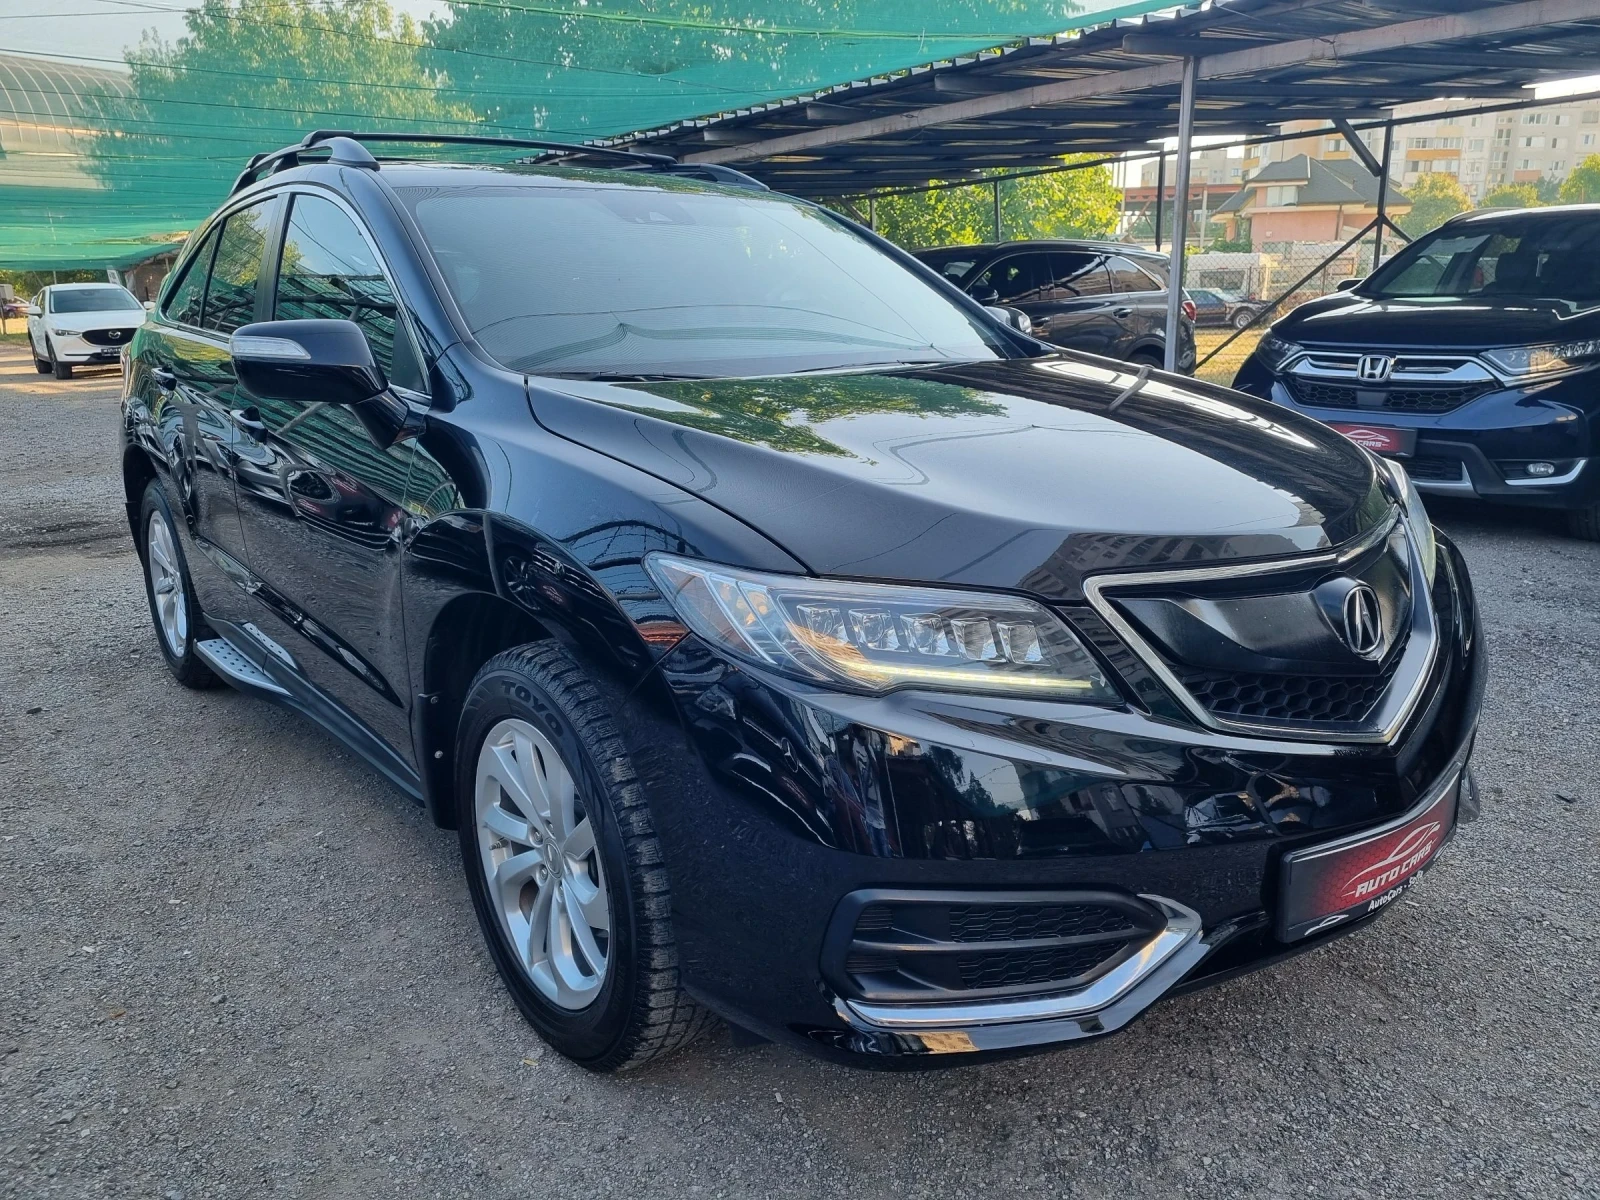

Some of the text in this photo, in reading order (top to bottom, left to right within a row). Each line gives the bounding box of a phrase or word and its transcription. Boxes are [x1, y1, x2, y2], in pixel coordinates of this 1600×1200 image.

[501, 680, 564, 737] TOYO
[1355, 841, 1432, 898] AUTO CARS
[1367, 886, 1403, 911] AutoCars
